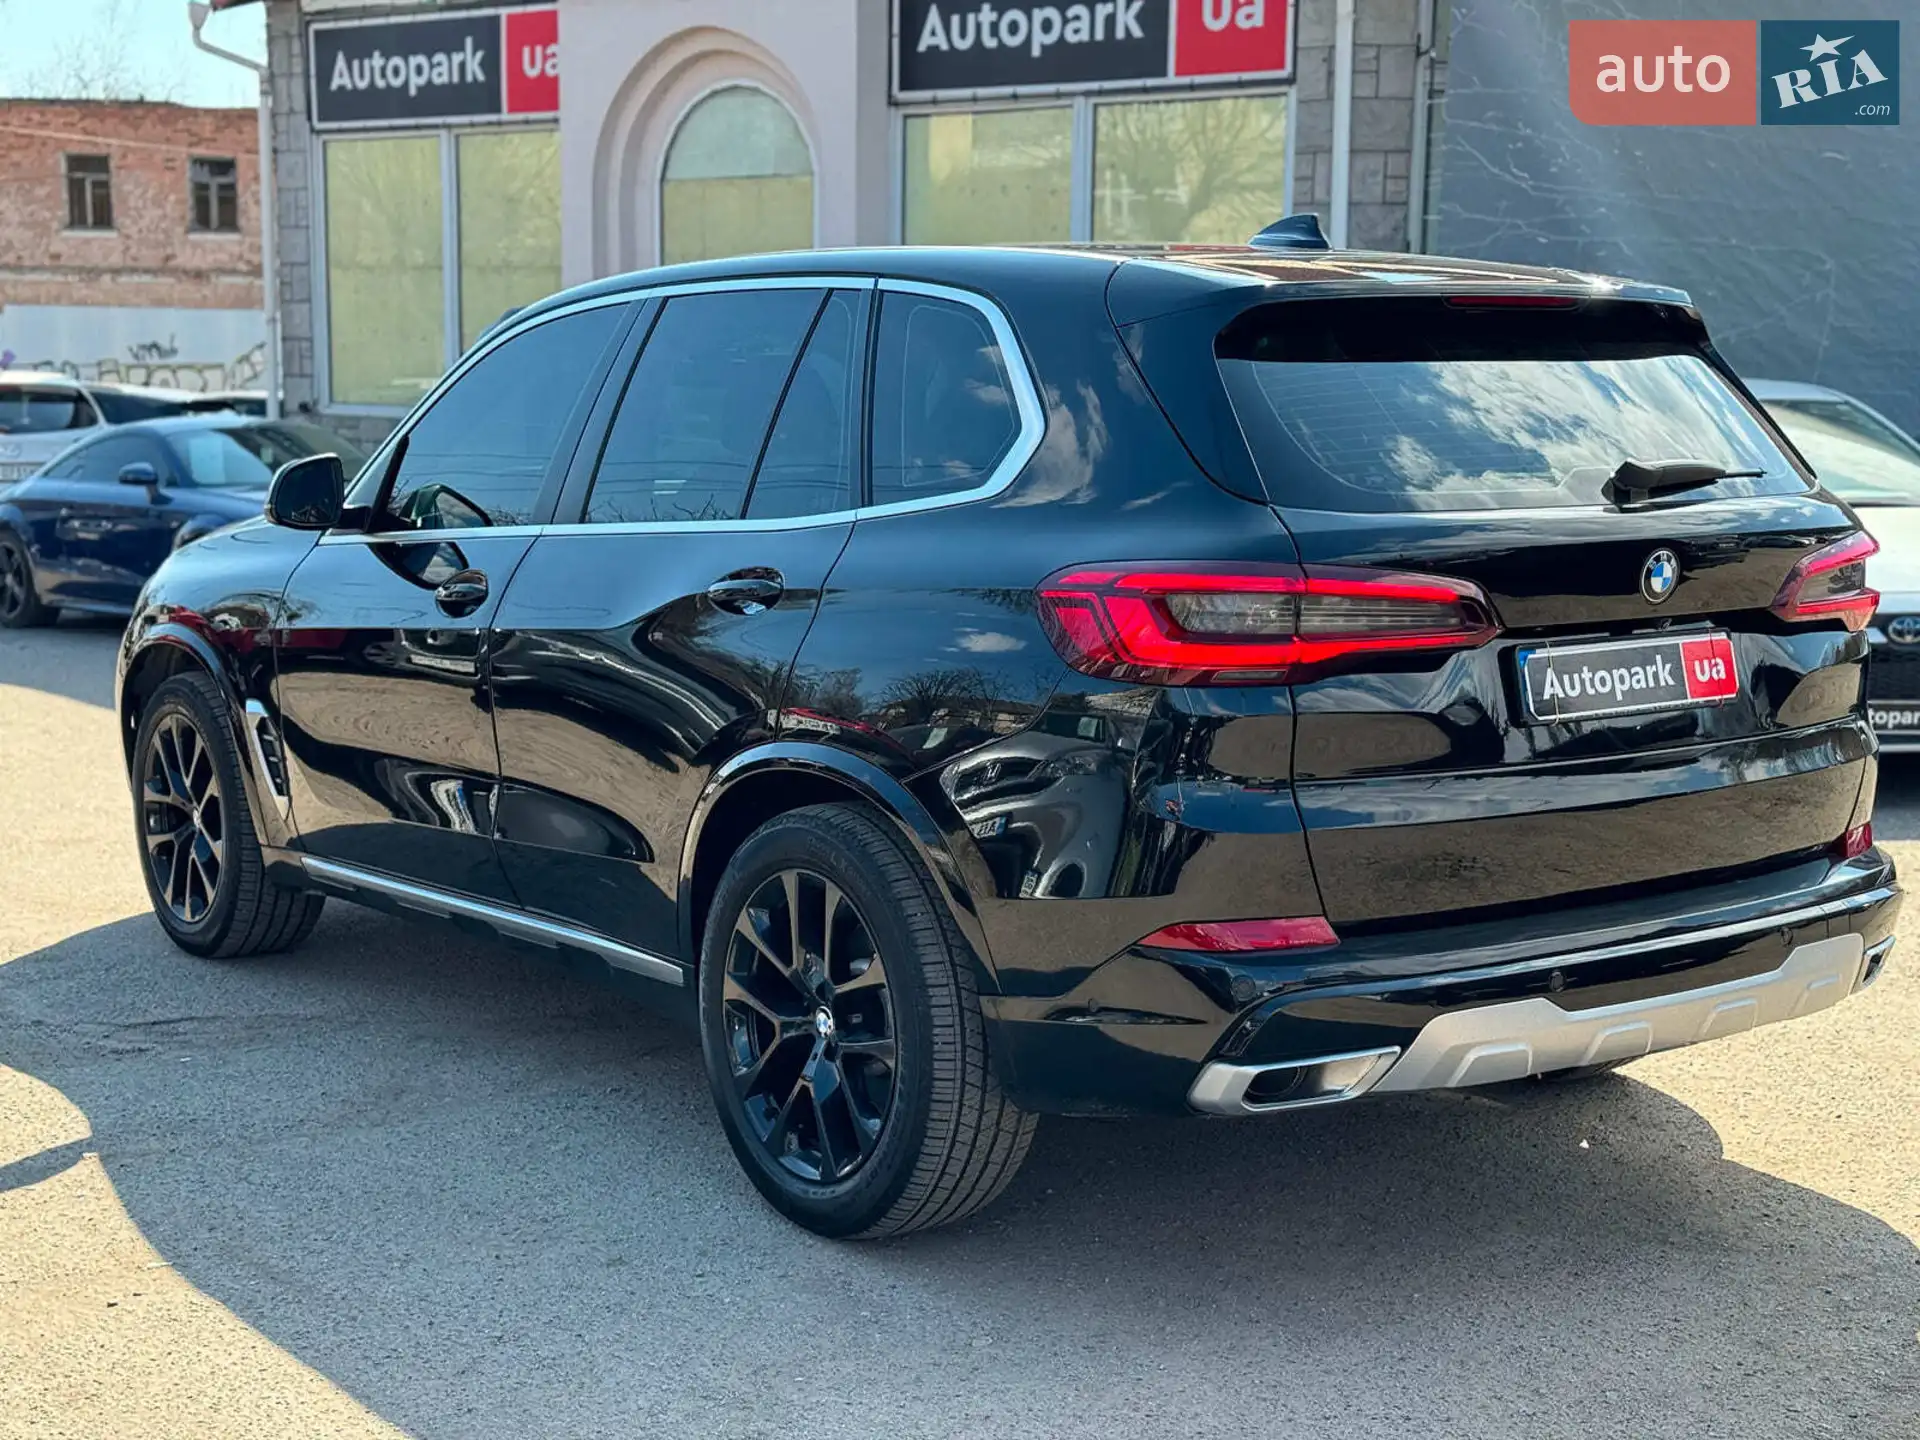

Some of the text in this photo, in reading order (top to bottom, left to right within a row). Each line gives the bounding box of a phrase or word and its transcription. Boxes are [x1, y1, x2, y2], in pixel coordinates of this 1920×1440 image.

[916, 0, 1145, 57] Autopark
[329, 36, 485, 97] Autopark
[1542, 654, 1727, 700] Autopark ua
